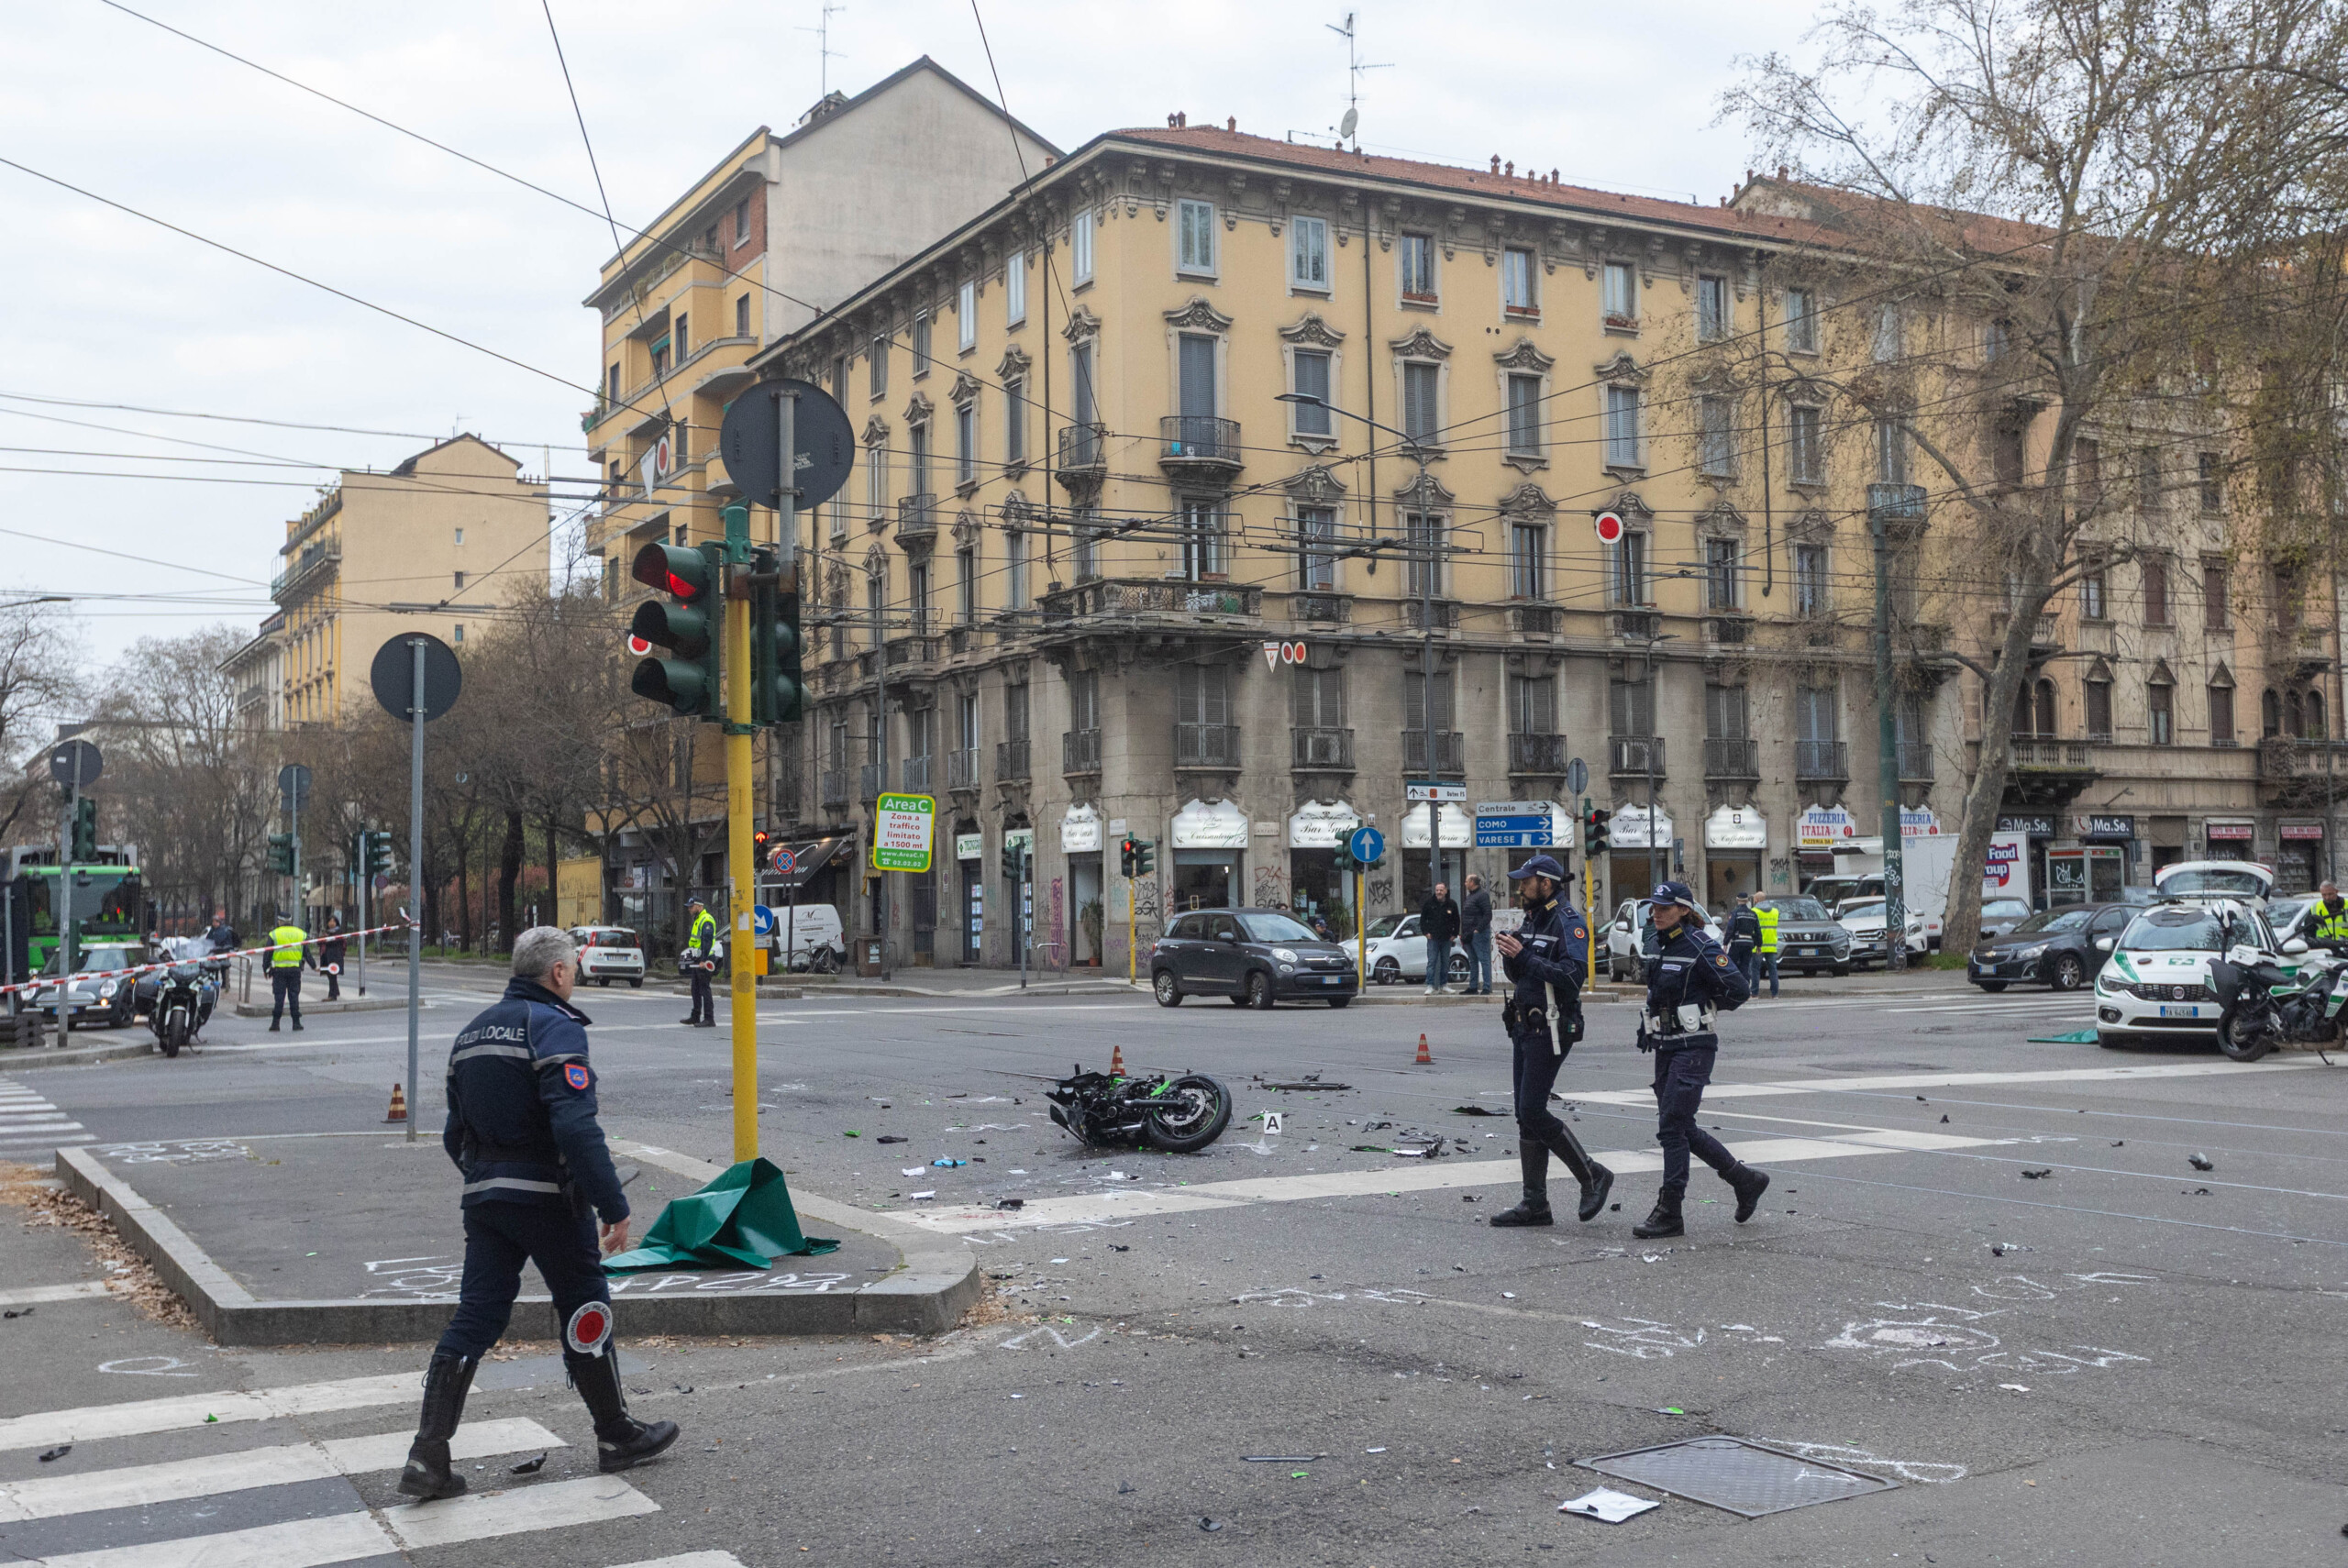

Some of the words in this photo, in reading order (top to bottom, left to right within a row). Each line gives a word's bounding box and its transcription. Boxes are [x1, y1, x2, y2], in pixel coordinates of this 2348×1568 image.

[884, 798, 916, 811] Area
[891, 812, 913, 821] Zona
[1808, 812, 1846, 824] PIZZERIA
[1899, 812, 1932, 824] IZZERIA
[889, 822, 921, 831] traffico
[1300, 822, 1321, 834] Bar
[1327, 821, 1351, 833] Gust
[1478, 821, 1507, 829] COMO
[1619, 824, 1637, 834] Bar
[1801, 825, 1831, 836] ITALIA
[1899, 825, 1918, 836] ALIA
[2013, 818, 2051, 832] Ma.Se.
[2094, 818, 2130, 833] Ma.Se.
[887, 831, 921, 840] limitato
[1479, 835, 1515, 844] VARESE
[1721, 834, 1755, 845] Caffetteria
[1988, 845, 2016, 859] Food
[480, 1025, 526, 1042] LOCALE
[1266, 1115, 1279, 1130] A
[570, 1312, 581, 1342] COMUNE
[593, 1304, 610, 1320] MILANO
